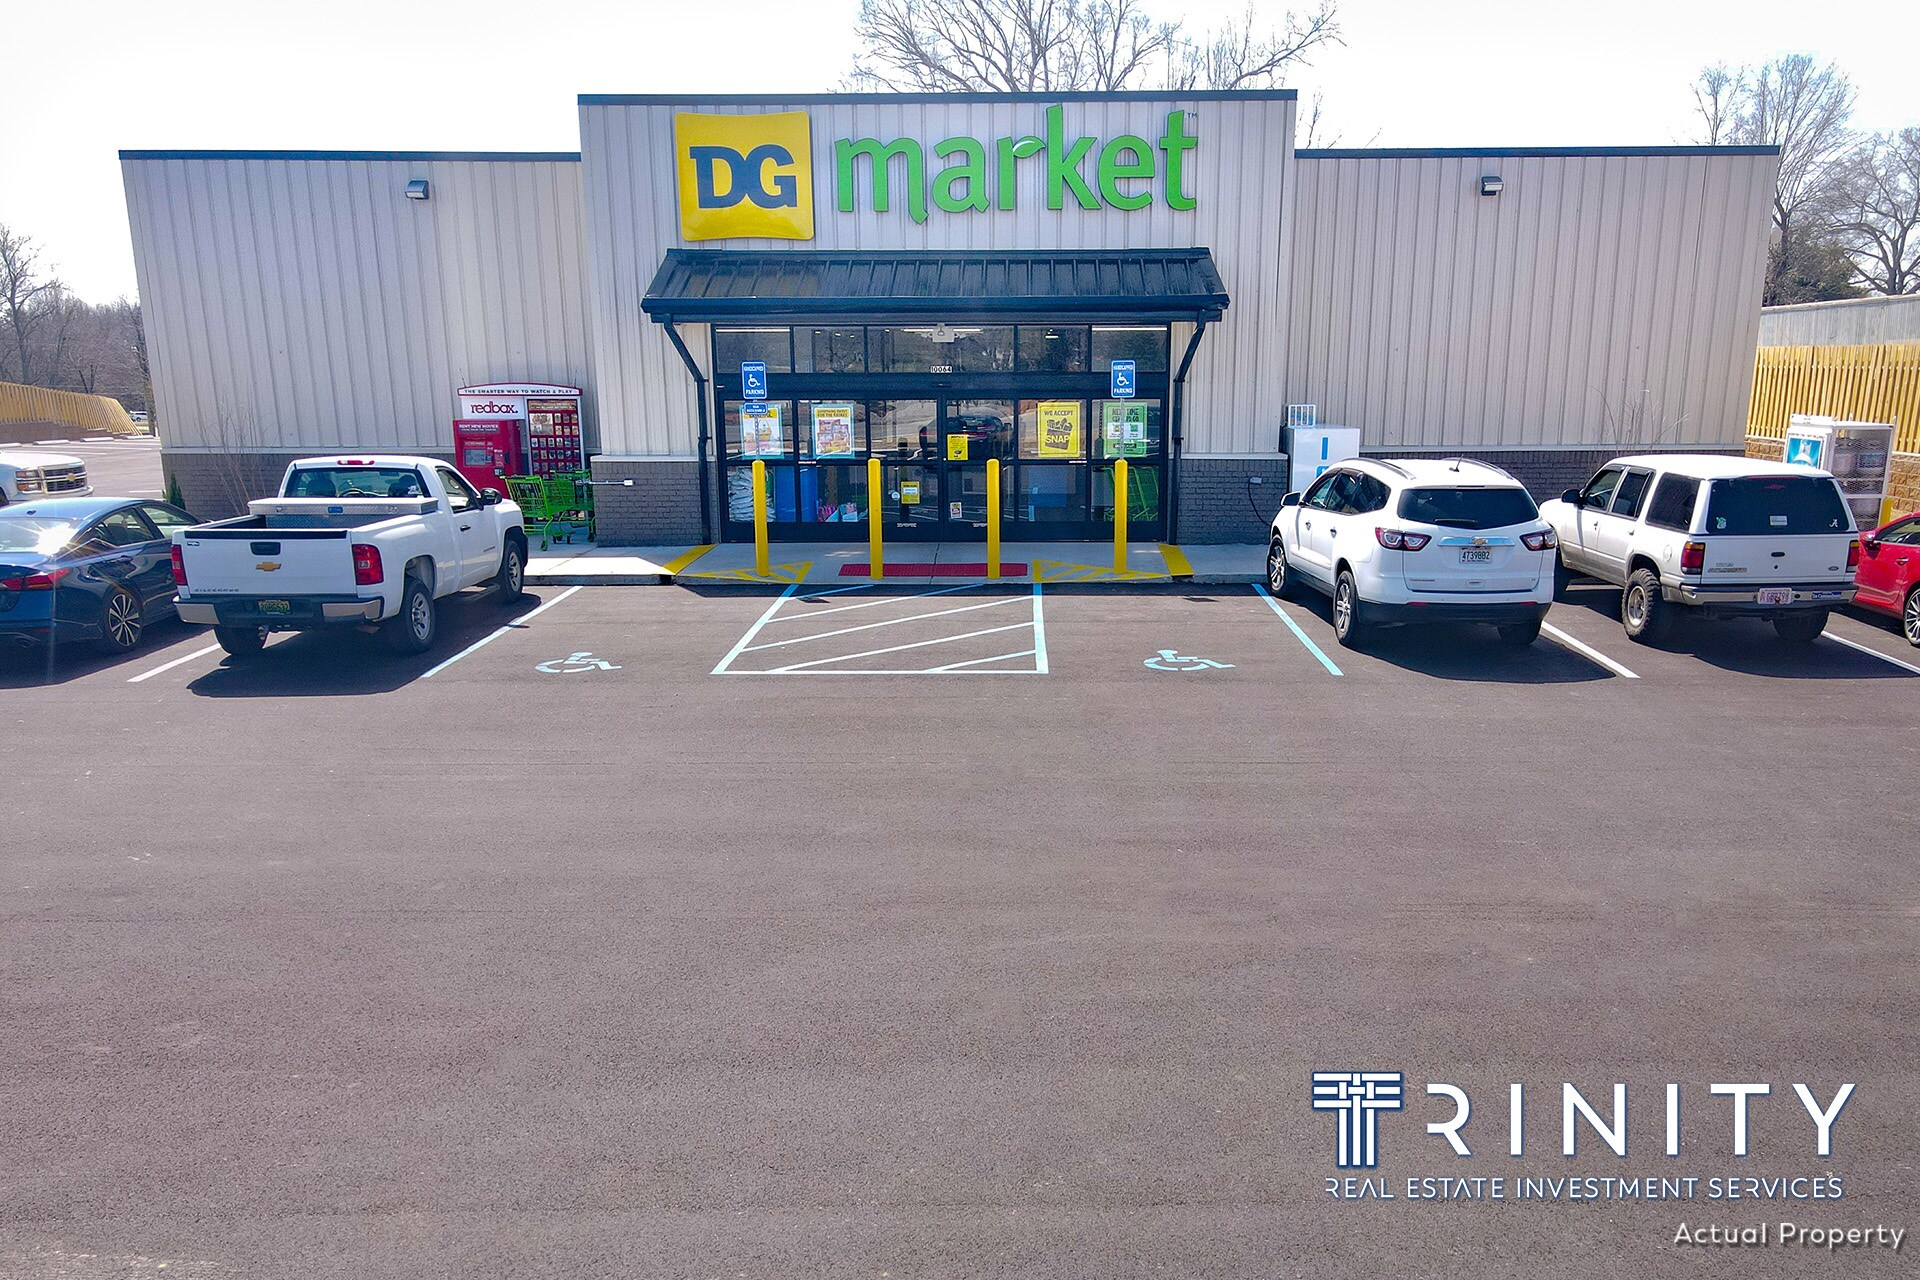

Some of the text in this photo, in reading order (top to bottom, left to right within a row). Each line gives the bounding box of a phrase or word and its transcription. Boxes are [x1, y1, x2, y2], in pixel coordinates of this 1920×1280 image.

[688, 144, 798, 209] DG
[834, 105, 1199, 224] market
[1045, 434, 1070, 444] SNAP
